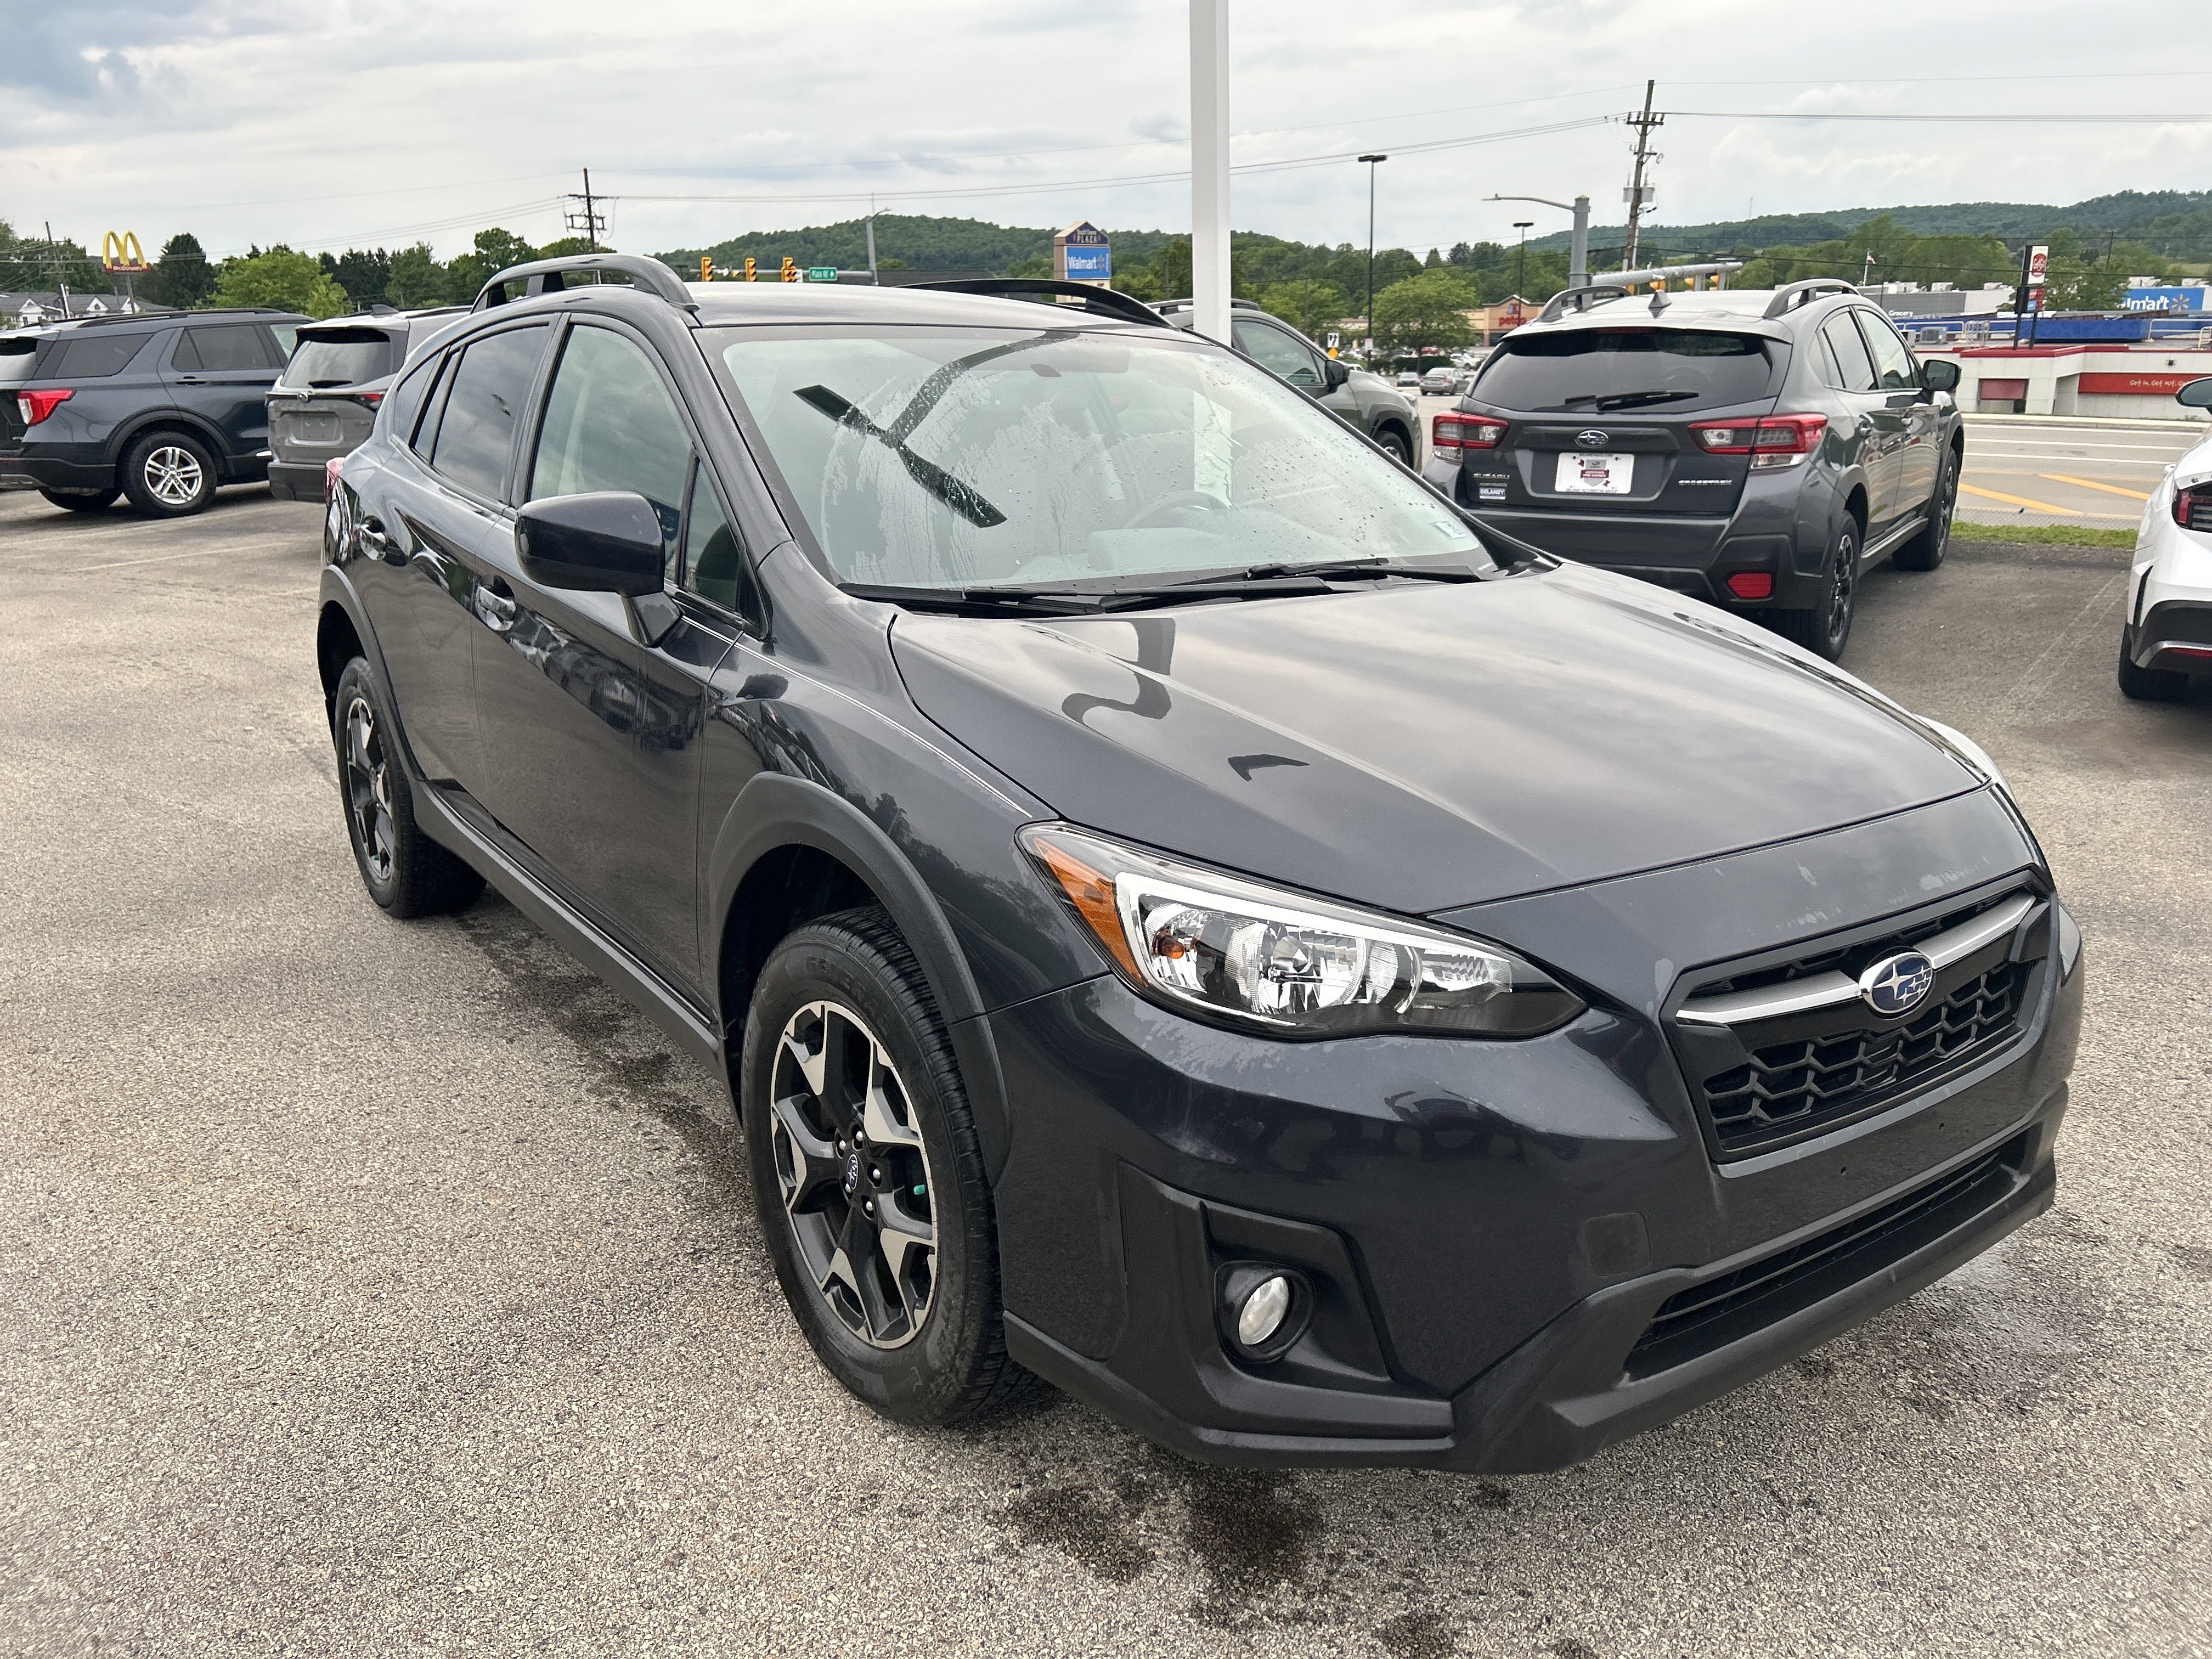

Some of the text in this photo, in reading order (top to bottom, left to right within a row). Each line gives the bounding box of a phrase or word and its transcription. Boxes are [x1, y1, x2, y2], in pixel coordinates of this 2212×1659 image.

[1076, 235, 1098, 243] PLAZA
[1068, 256, 1097, 269] Walmart
[2118, 296, 2170, 311] lmart
